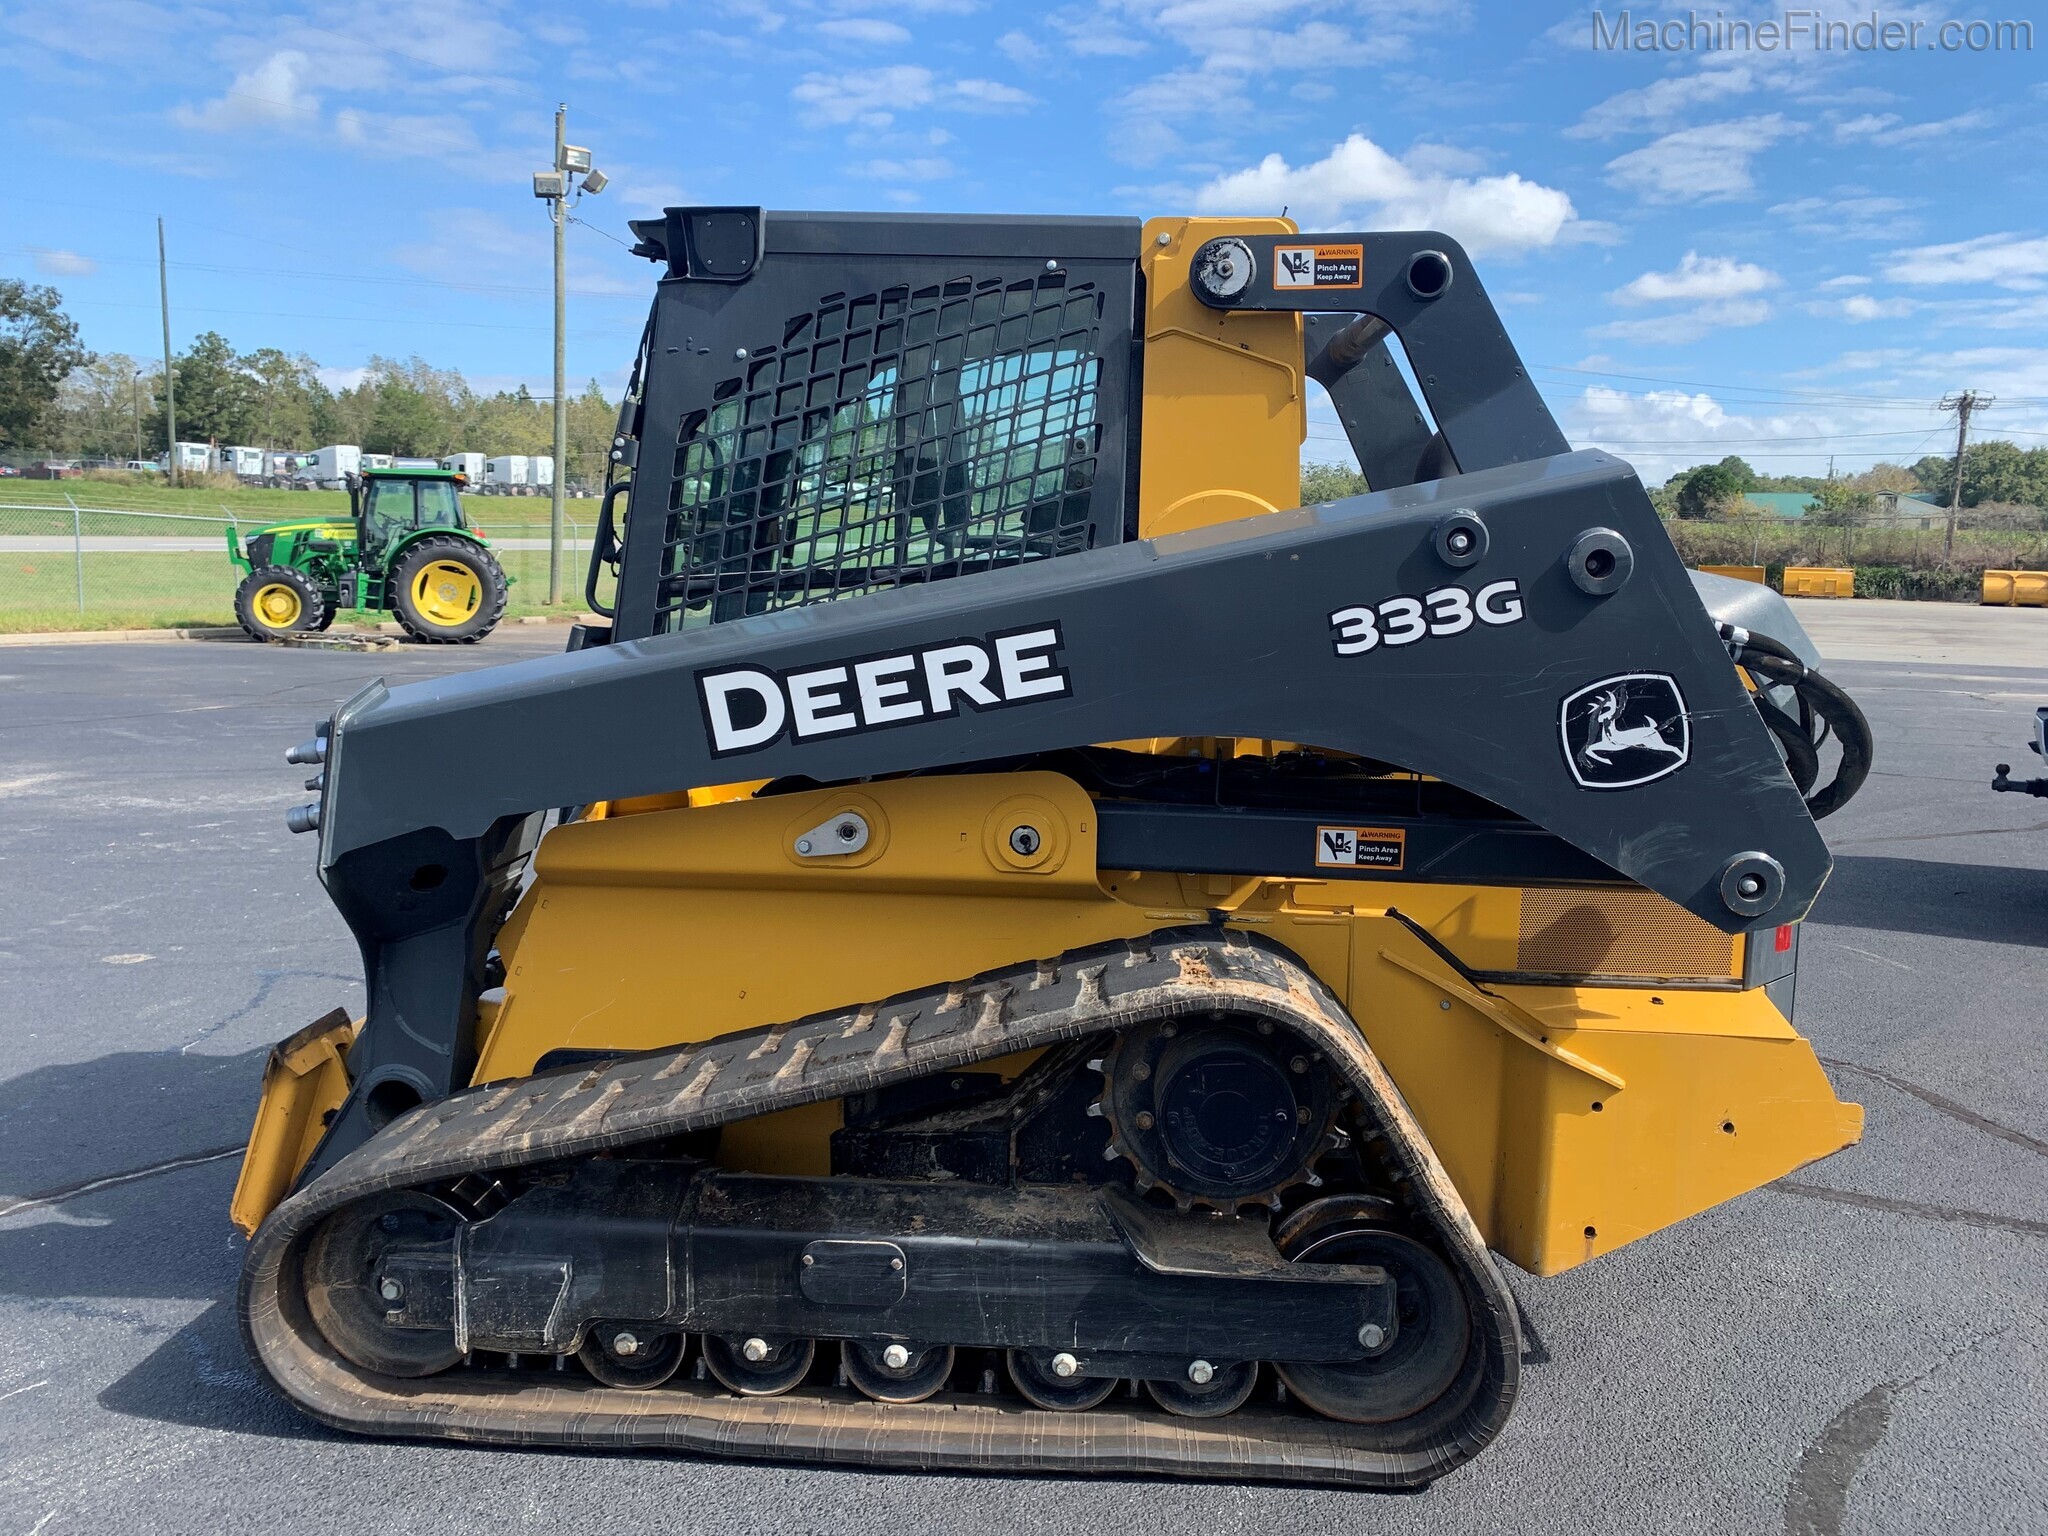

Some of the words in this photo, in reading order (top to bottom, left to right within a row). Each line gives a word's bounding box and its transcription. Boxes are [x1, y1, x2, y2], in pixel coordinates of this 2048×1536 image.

[1316, 273, 1333, 281] Keep
[1333, 273, 1351, 281] Away
[1331, 580, 1524, 655] 333G
[702, 629, 1065, 752] DEERE
[1359, 845, 1380, 853] Pinch
[1358, 853, 1375, 861] Keep
[1375, 854, 1393, 862] Away
